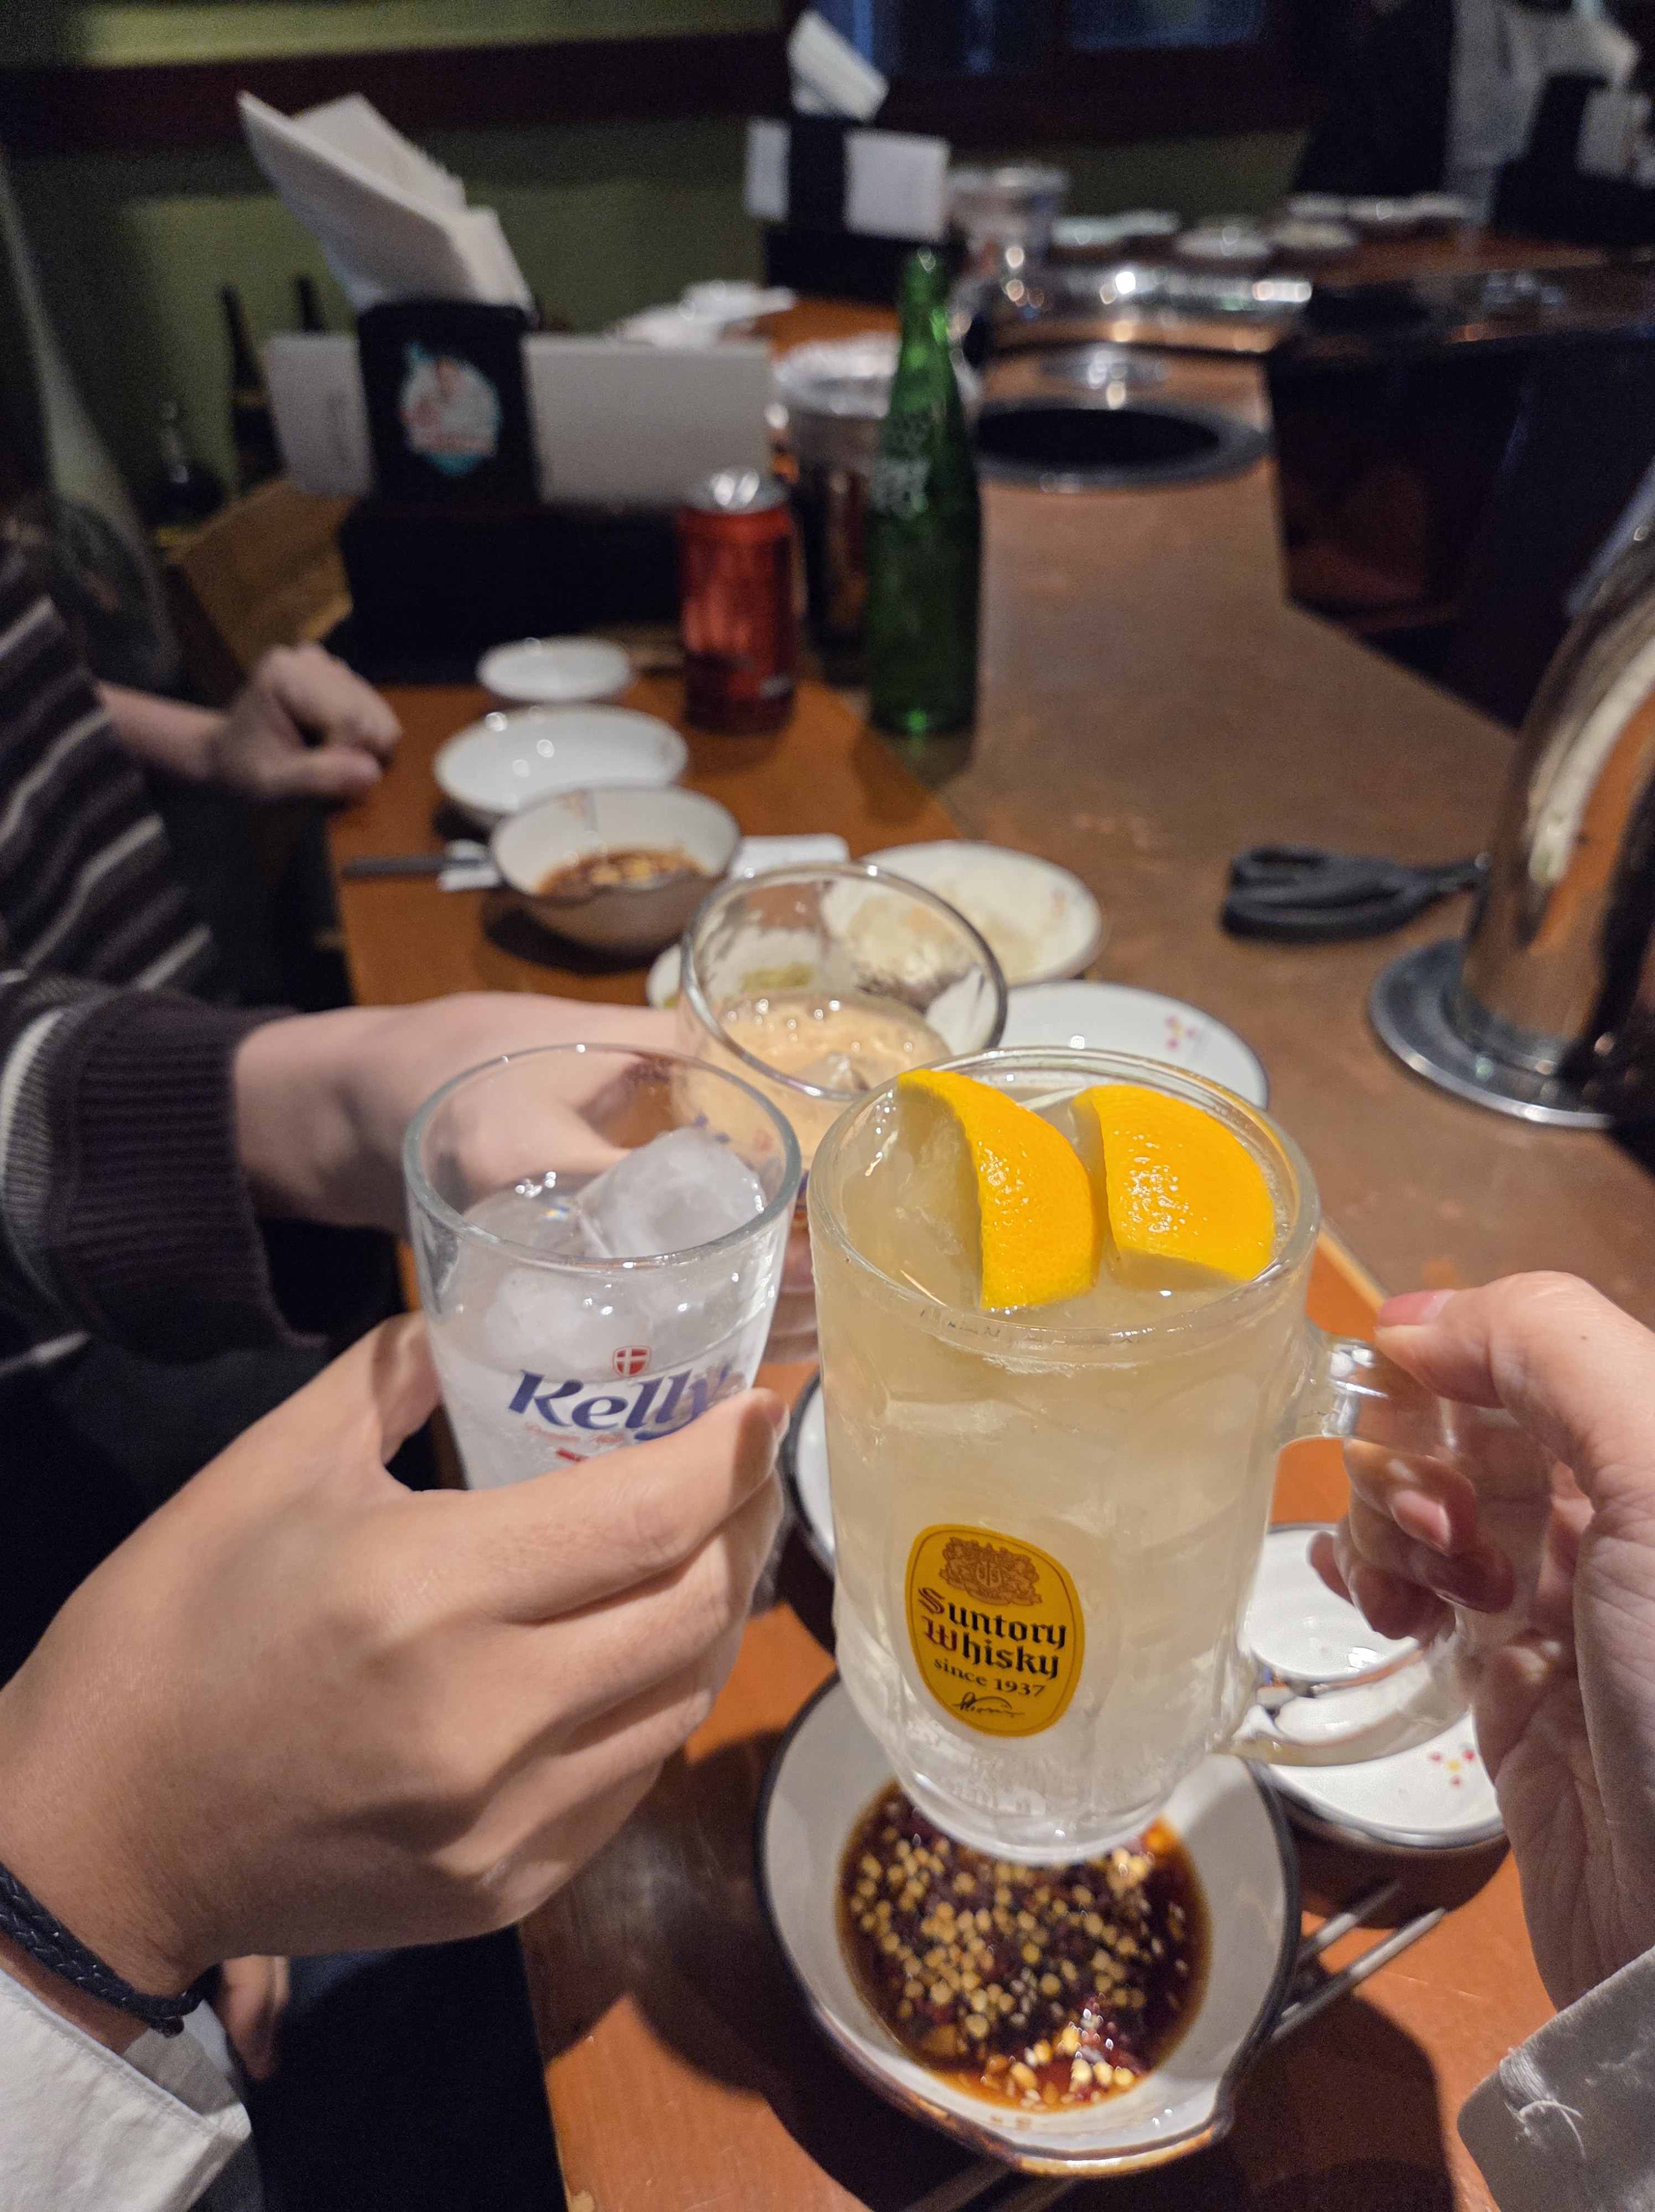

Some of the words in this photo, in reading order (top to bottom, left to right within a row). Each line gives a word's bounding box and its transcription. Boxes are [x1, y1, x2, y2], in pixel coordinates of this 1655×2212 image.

[508, 1363, 732, 1442] Kelly
[918, 1587, 1066, 1650] Suntory
[921, 1616, 1060, 1680] Whisky
[934, 1658, 988, 1687] since
[995, 1678, 1047, 1697] 1937
